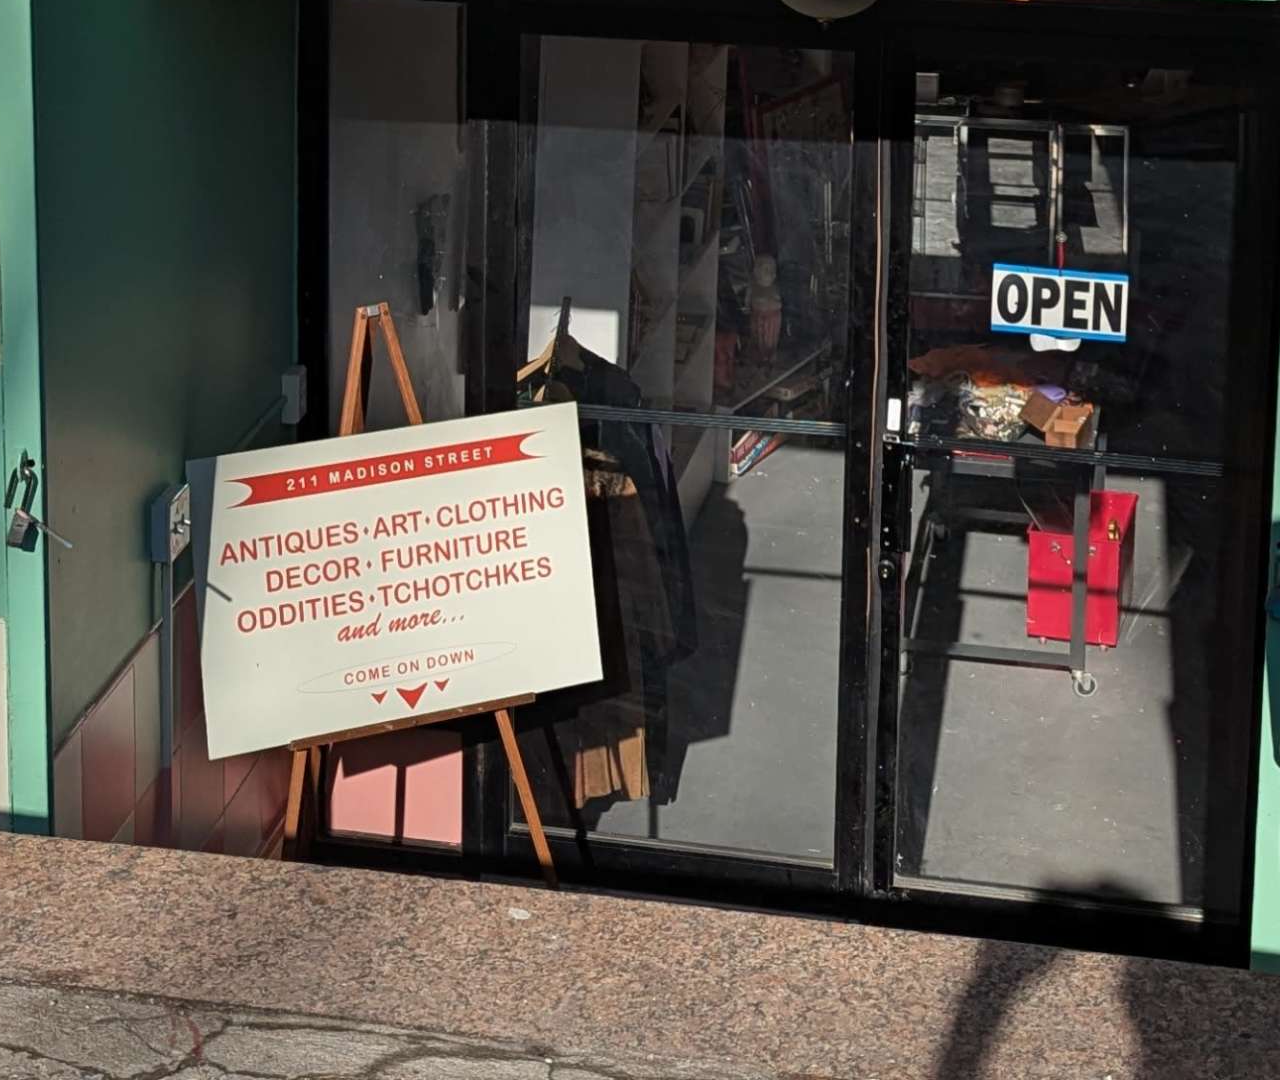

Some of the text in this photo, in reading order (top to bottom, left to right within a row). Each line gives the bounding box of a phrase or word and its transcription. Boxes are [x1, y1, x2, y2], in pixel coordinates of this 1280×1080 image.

[997, 273, 1123, 333] OPEN
[286, 446, 494, 491] 211 MADISON STREET
[220, 487, 565, 566] ANTIQUES ART CLOTHING
[265, 526, 528, 593] DECOR FURNITURE
[236, 556, 552, 633] ODDITIES TCHOTCHKES
[337, 607, 465, 642] and more...
[343, 648, 475, 686] COME ON DOWN
